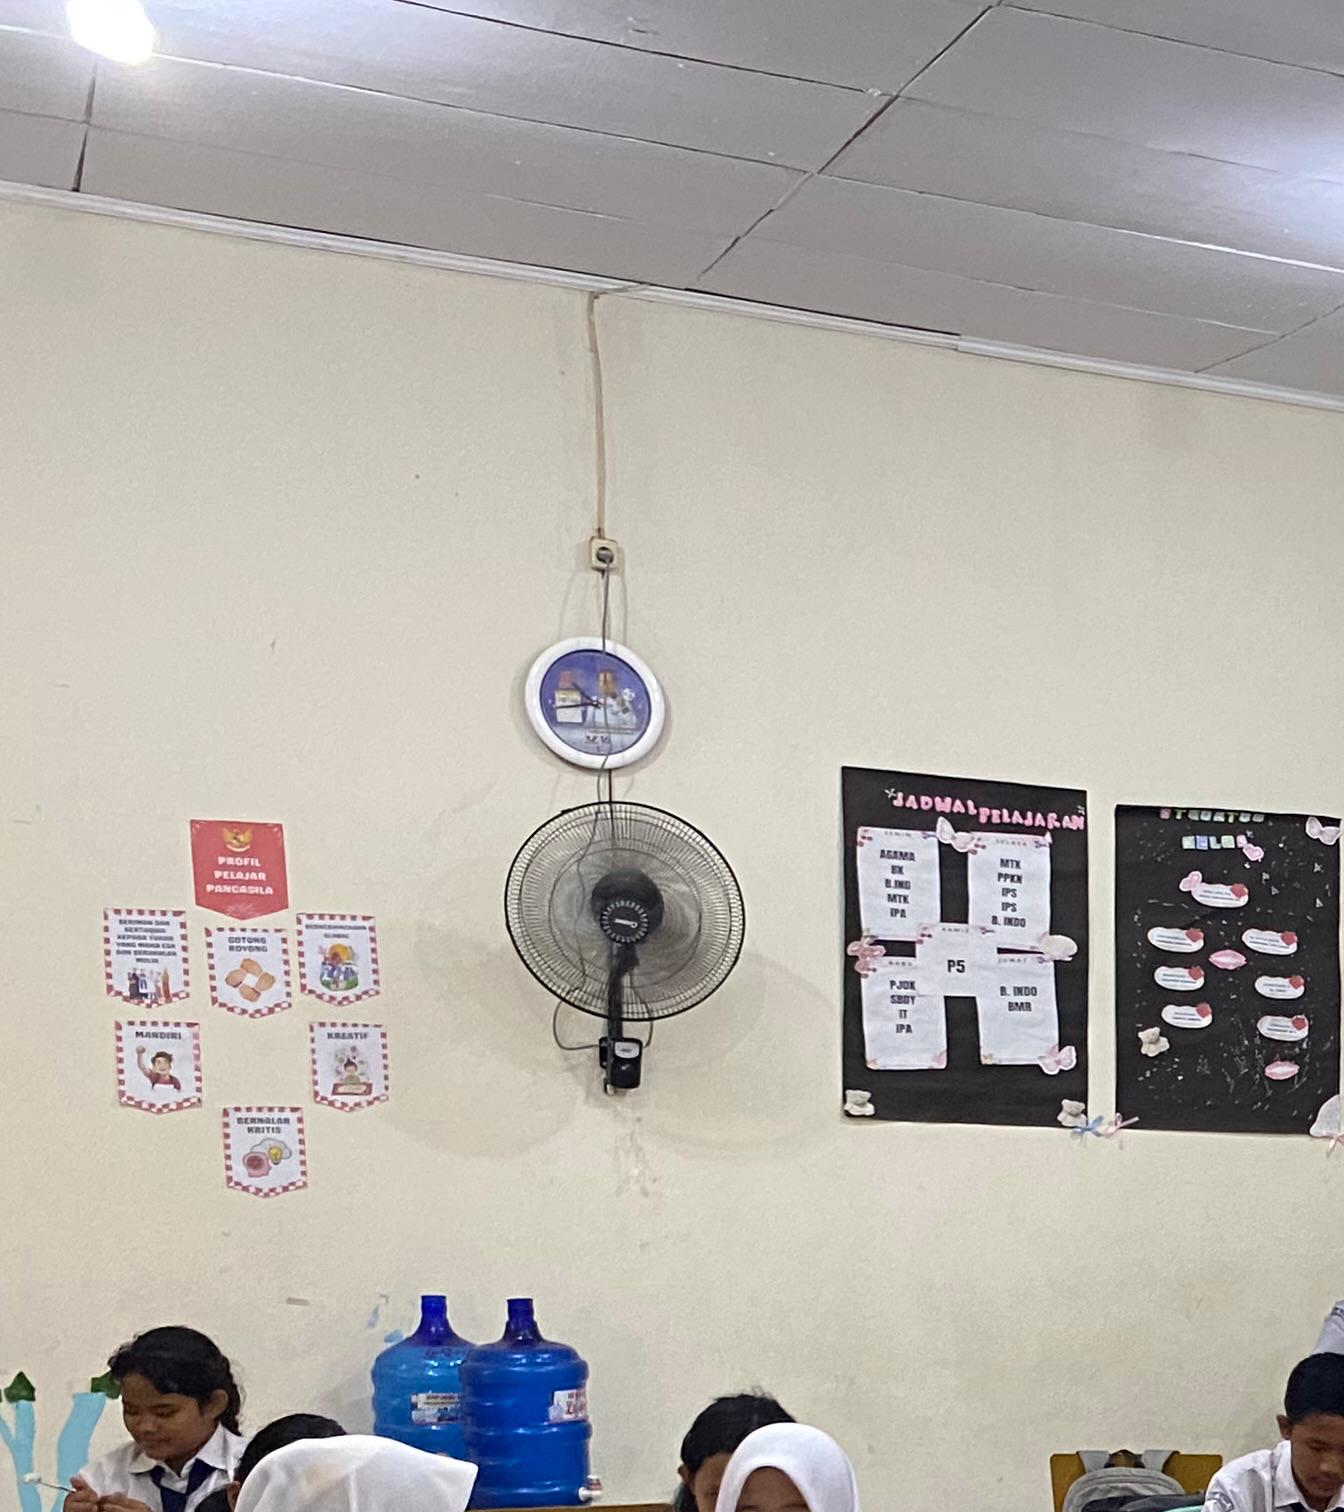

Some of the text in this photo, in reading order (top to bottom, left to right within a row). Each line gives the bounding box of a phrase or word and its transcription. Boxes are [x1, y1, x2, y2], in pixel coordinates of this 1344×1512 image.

[892, 792, 1085, 831] JADWAL PELAJARAN
[217, 856, 262, 867] PROFIL
[1000, 858, 1022, 870] MTK
[213, 870, 267, 881] PELAJAR
[997, 872, 1023, 884] PPKN
[206, 884, 274, 895] PANCASILA
[1001, 887, 1018, 898] IPS
[887, 893, 910, 904] MTK
[1001, 902, 1018, 912] IPS
[890, 908, 907, 918] IPA
[228, 936, 267, 944] GOTONG
[228, 945, 268, 953] ROYONG
[947, 959, 966, 973] P5
[1013, 986, 1038, 997] INDO
[896, 1024, 913, 1034] IPA
[135, 1031, 182, 1040] MANDIRI
